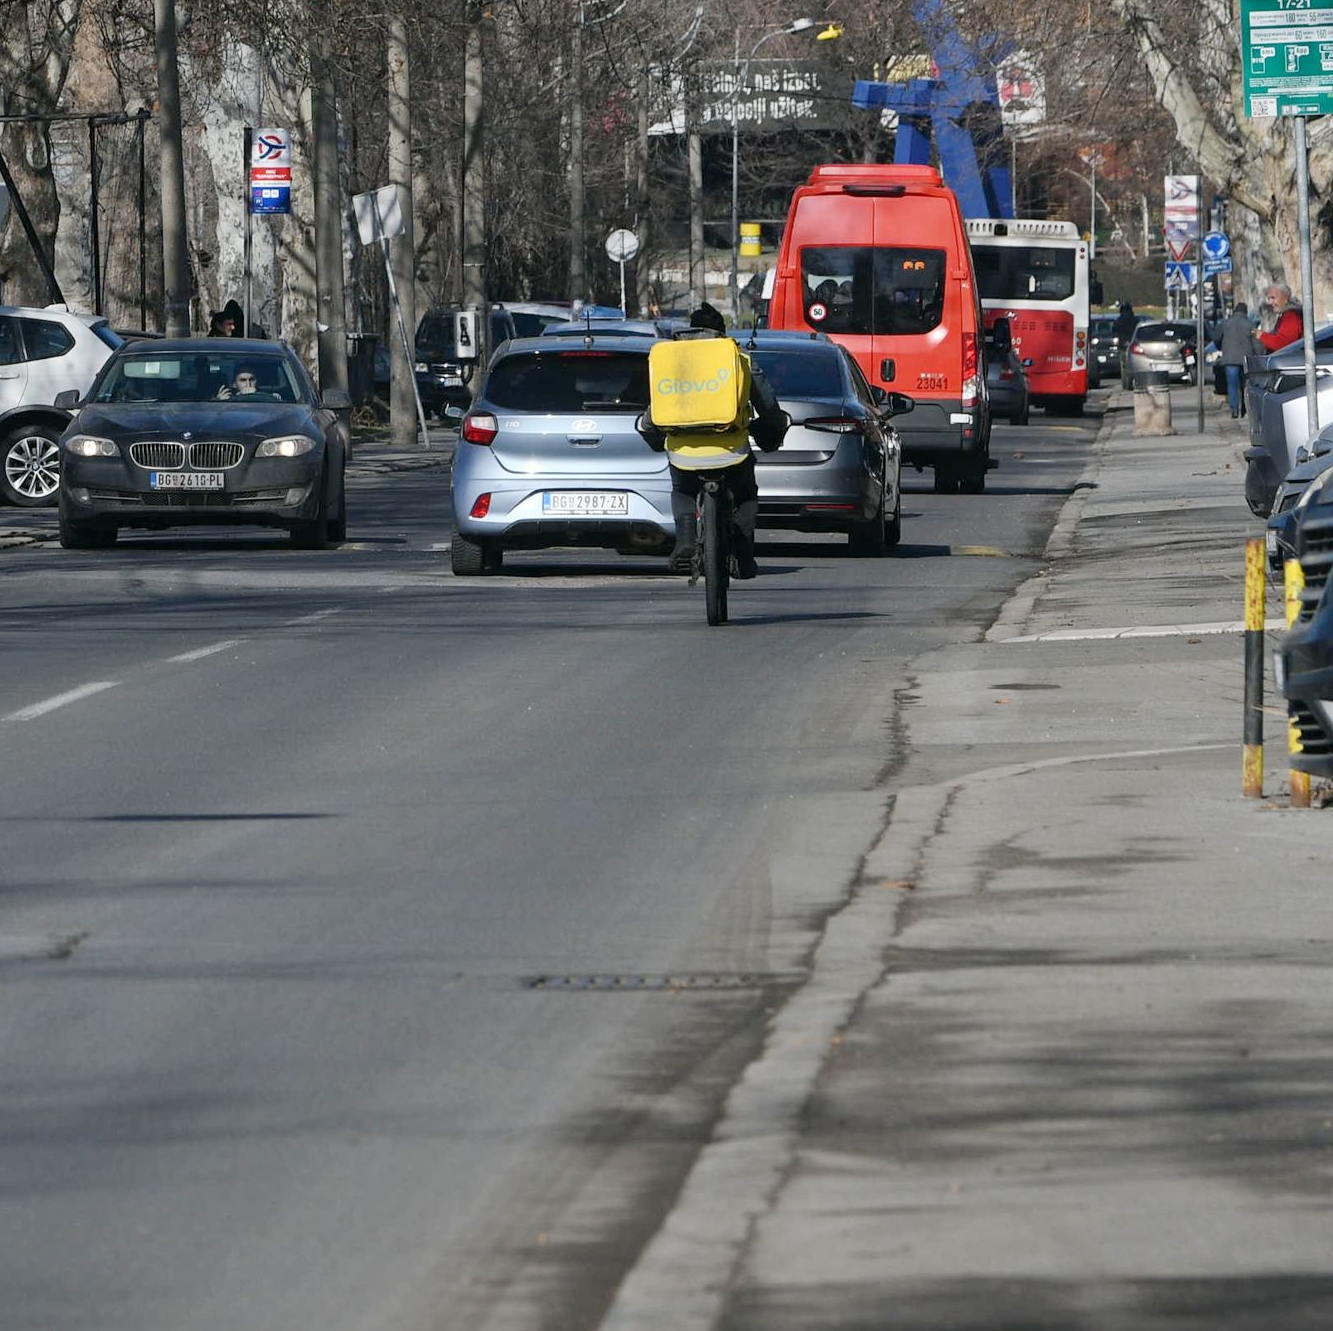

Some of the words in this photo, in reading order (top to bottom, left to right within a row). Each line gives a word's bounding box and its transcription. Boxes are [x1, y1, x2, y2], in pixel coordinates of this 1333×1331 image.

[813, 308, 823, 316] 50
[657, 379, 719, 395] Glovo
[916, 377, 949, 390] 23041
[158, 474, 172, 486] BG
[552, 495, 568, 509] BG
